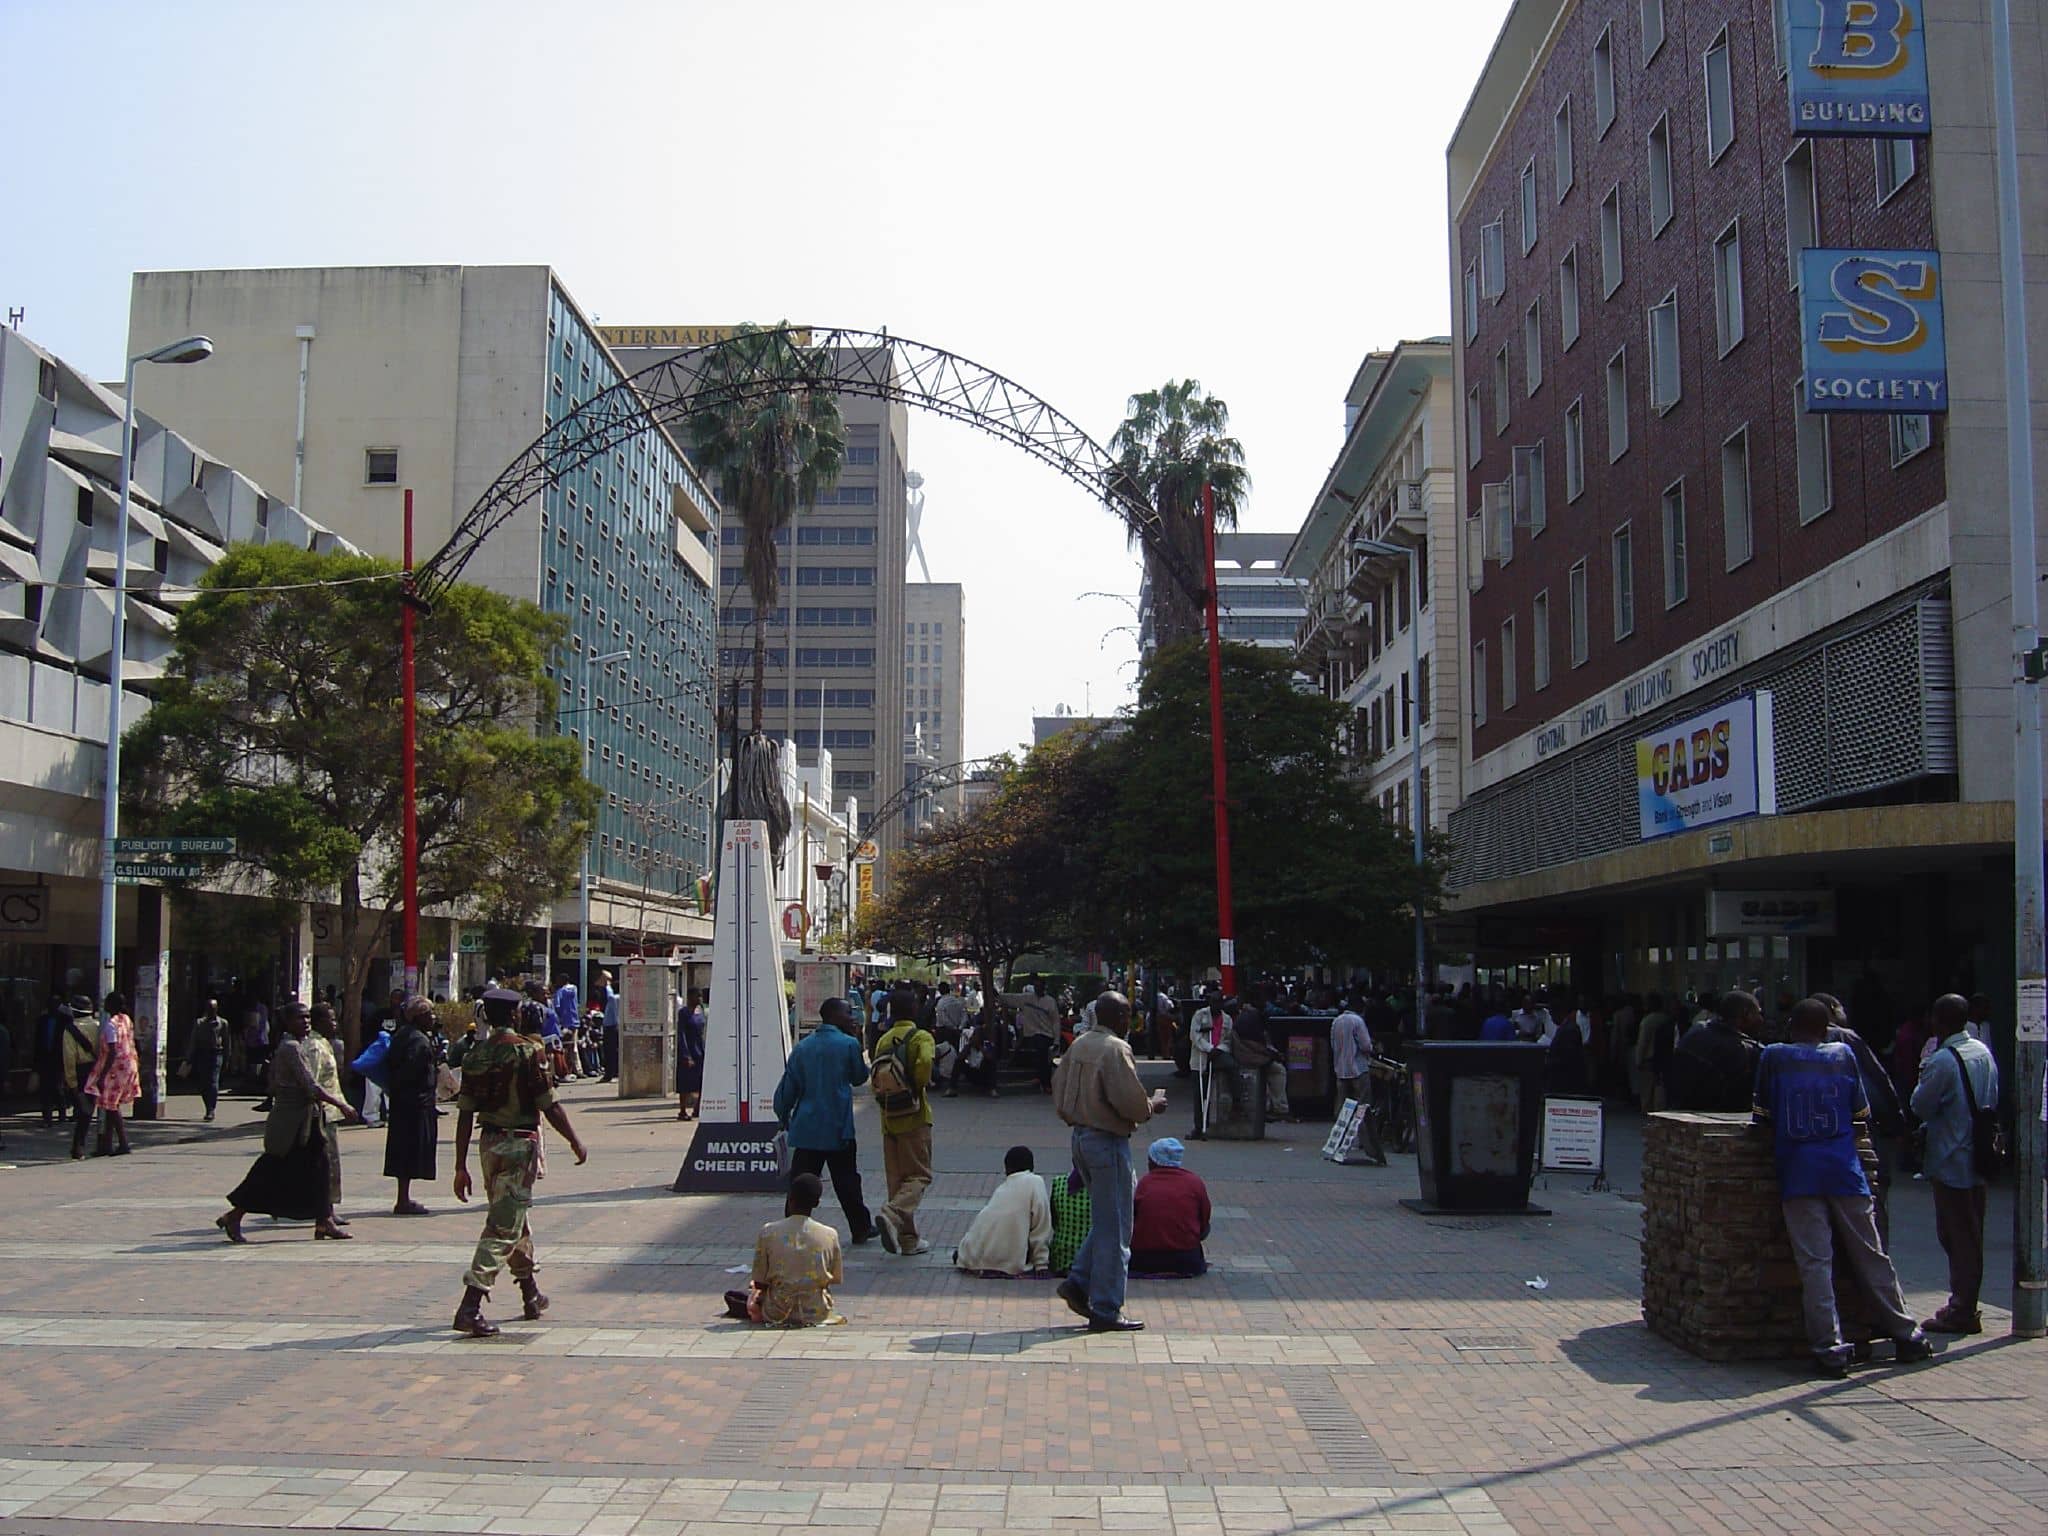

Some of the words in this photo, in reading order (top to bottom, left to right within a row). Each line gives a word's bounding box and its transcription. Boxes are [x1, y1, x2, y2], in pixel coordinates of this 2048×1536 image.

[1808, 0, 1906, 70] B
[1800, 102, 1925, 124] BUILDING
[1818, 255, 1928, 346] S
[1813, 378, 1943, 401] SOCIETY
[1536, 723, 1567, 757] CENTRAL
[1580, 701, 1609, 737] AFRICA
[1623, 668, 1672, 715] BUILDING
[1692, 630, 1740, 681] SOCIETY
[1652, 719, 1730, 797] CABS
[1676, 799, 1701, 819] Strength
[1713, 791, 1732, 809] Vision
[121, 840, 173, 850] PUBLICITY
[181, 840, 225, 851] BUREAU
[707, 1142, 774, 1154] MAYOR'S
[694, 1159, 746, 1172] CHEER
[750, 1160, 779, 1172] FUN
